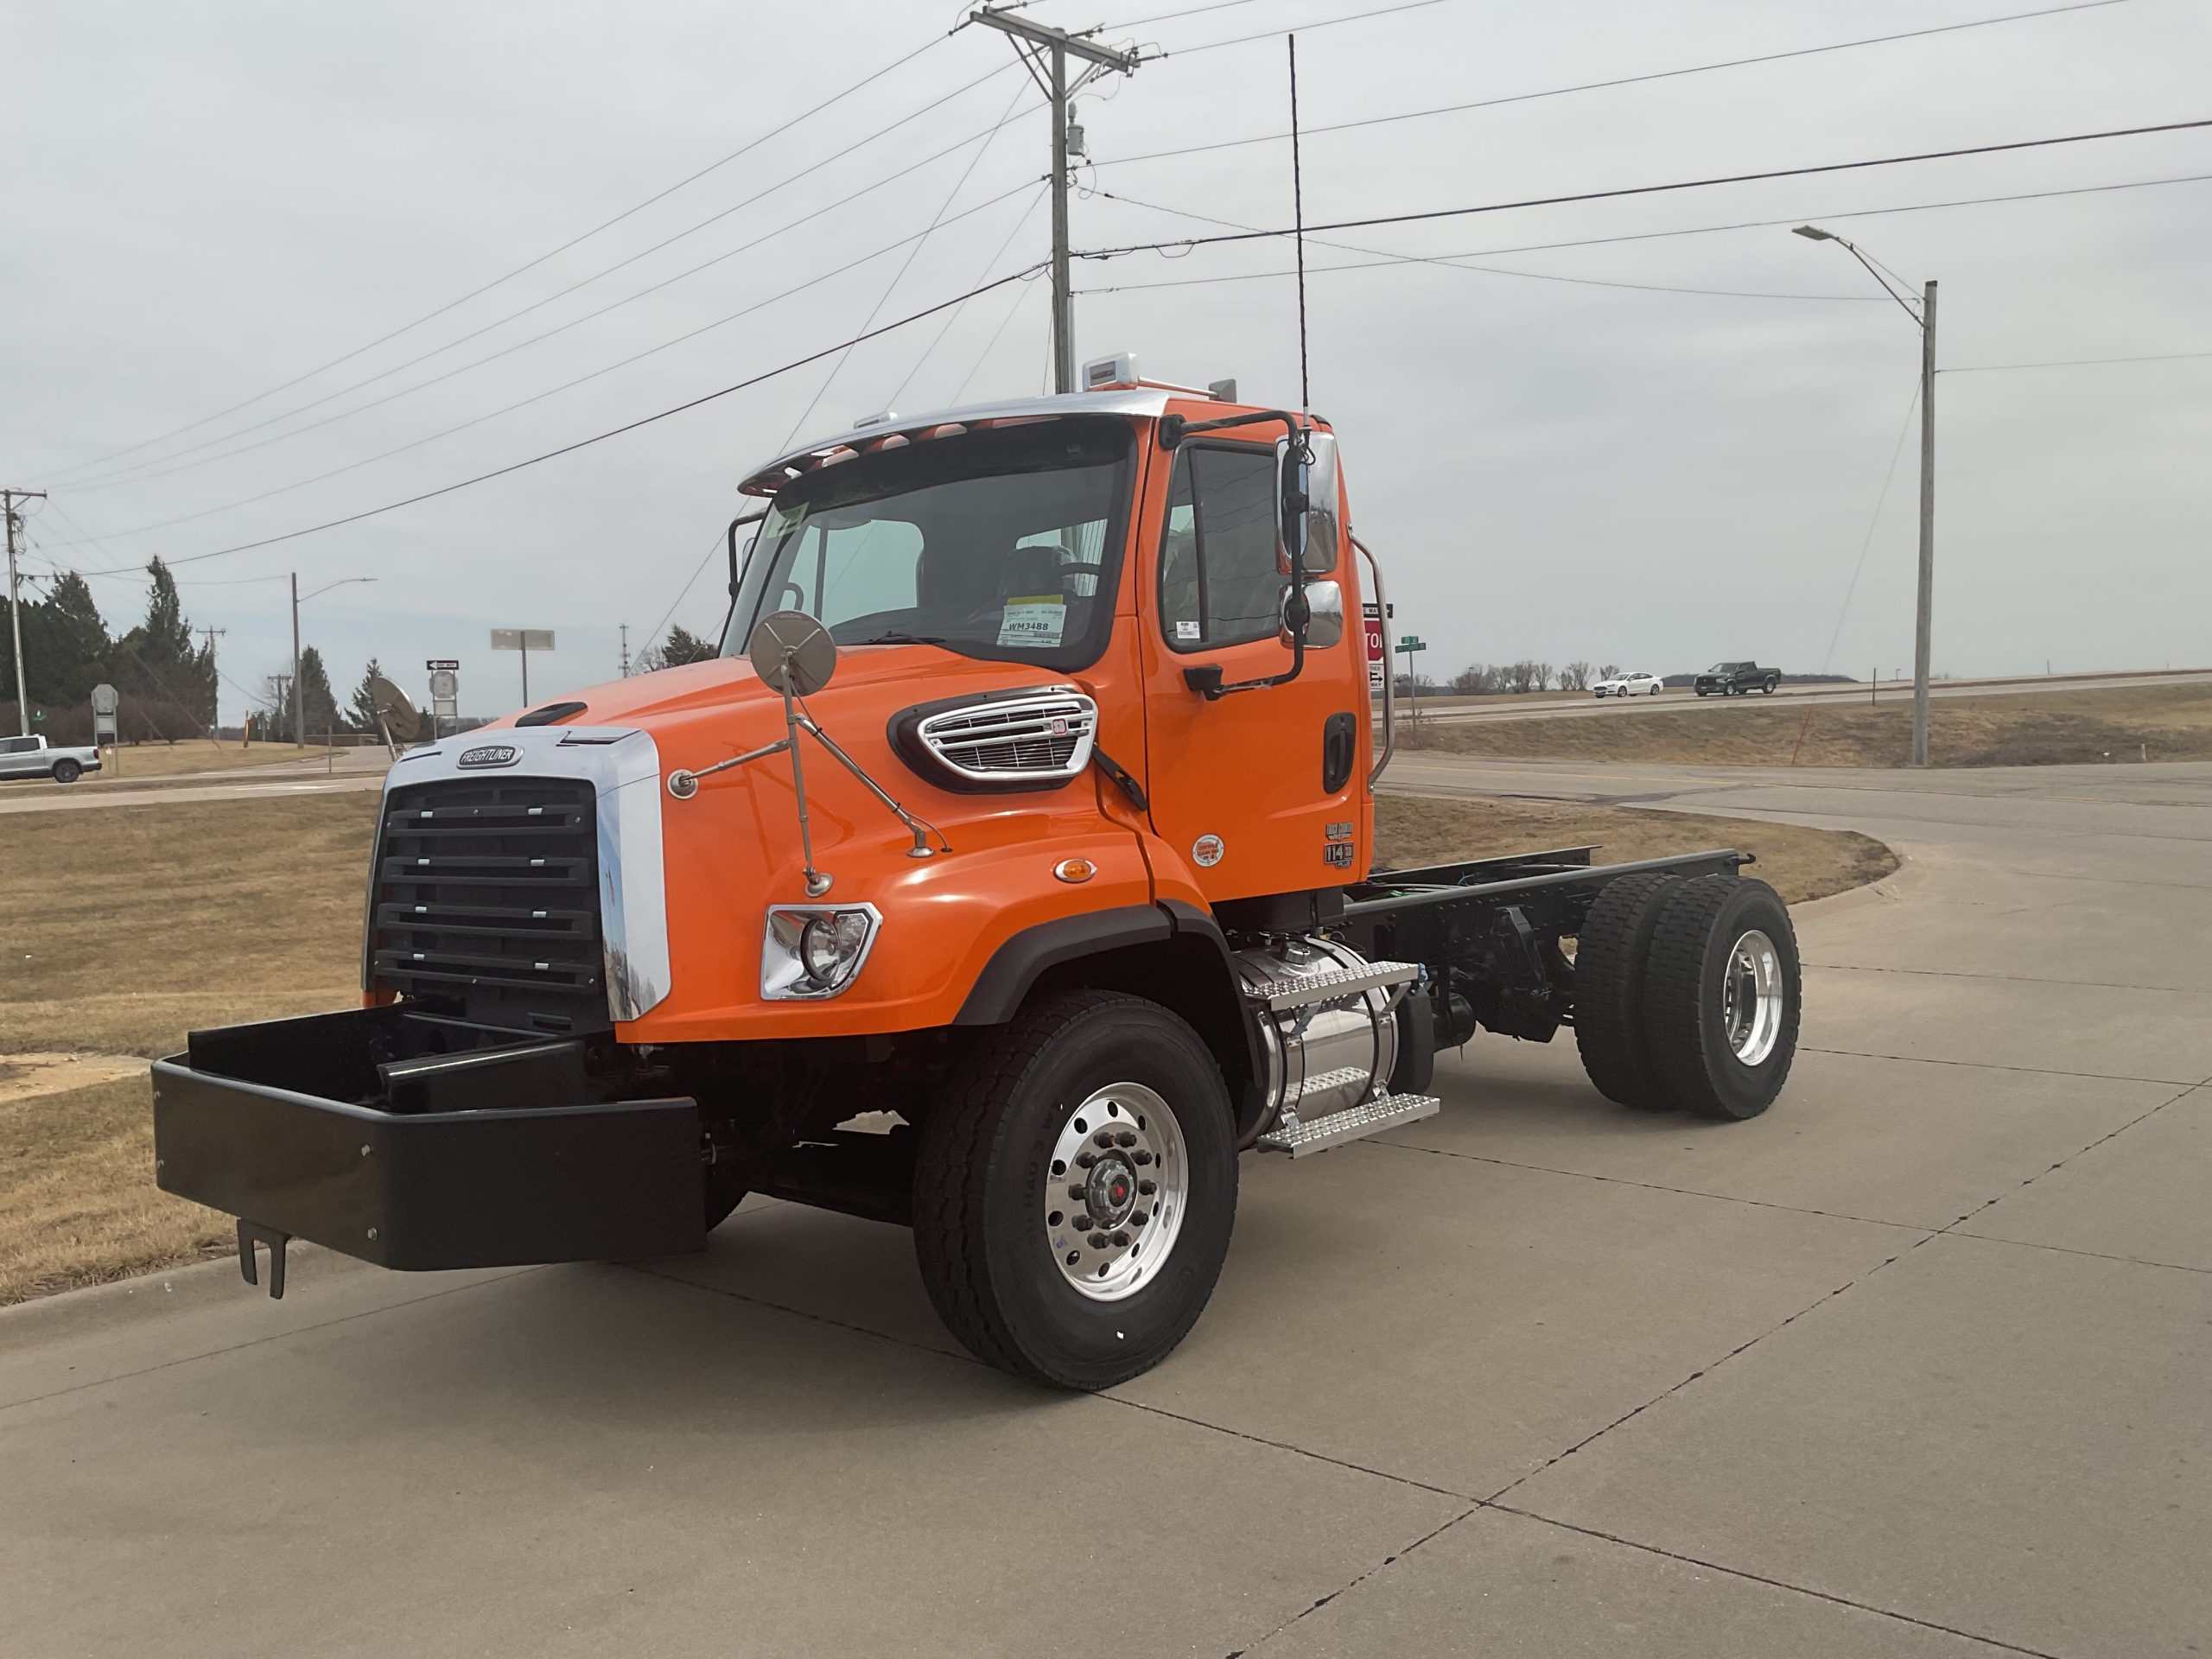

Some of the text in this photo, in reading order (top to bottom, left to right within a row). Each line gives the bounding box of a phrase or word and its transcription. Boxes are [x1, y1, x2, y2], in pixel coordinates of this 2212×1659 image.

[1008, 622, 1049, 631] WM3488
[461, 748, 513, 762] FREIGHTLINER
[1327, 844, 1343, 861] 114
